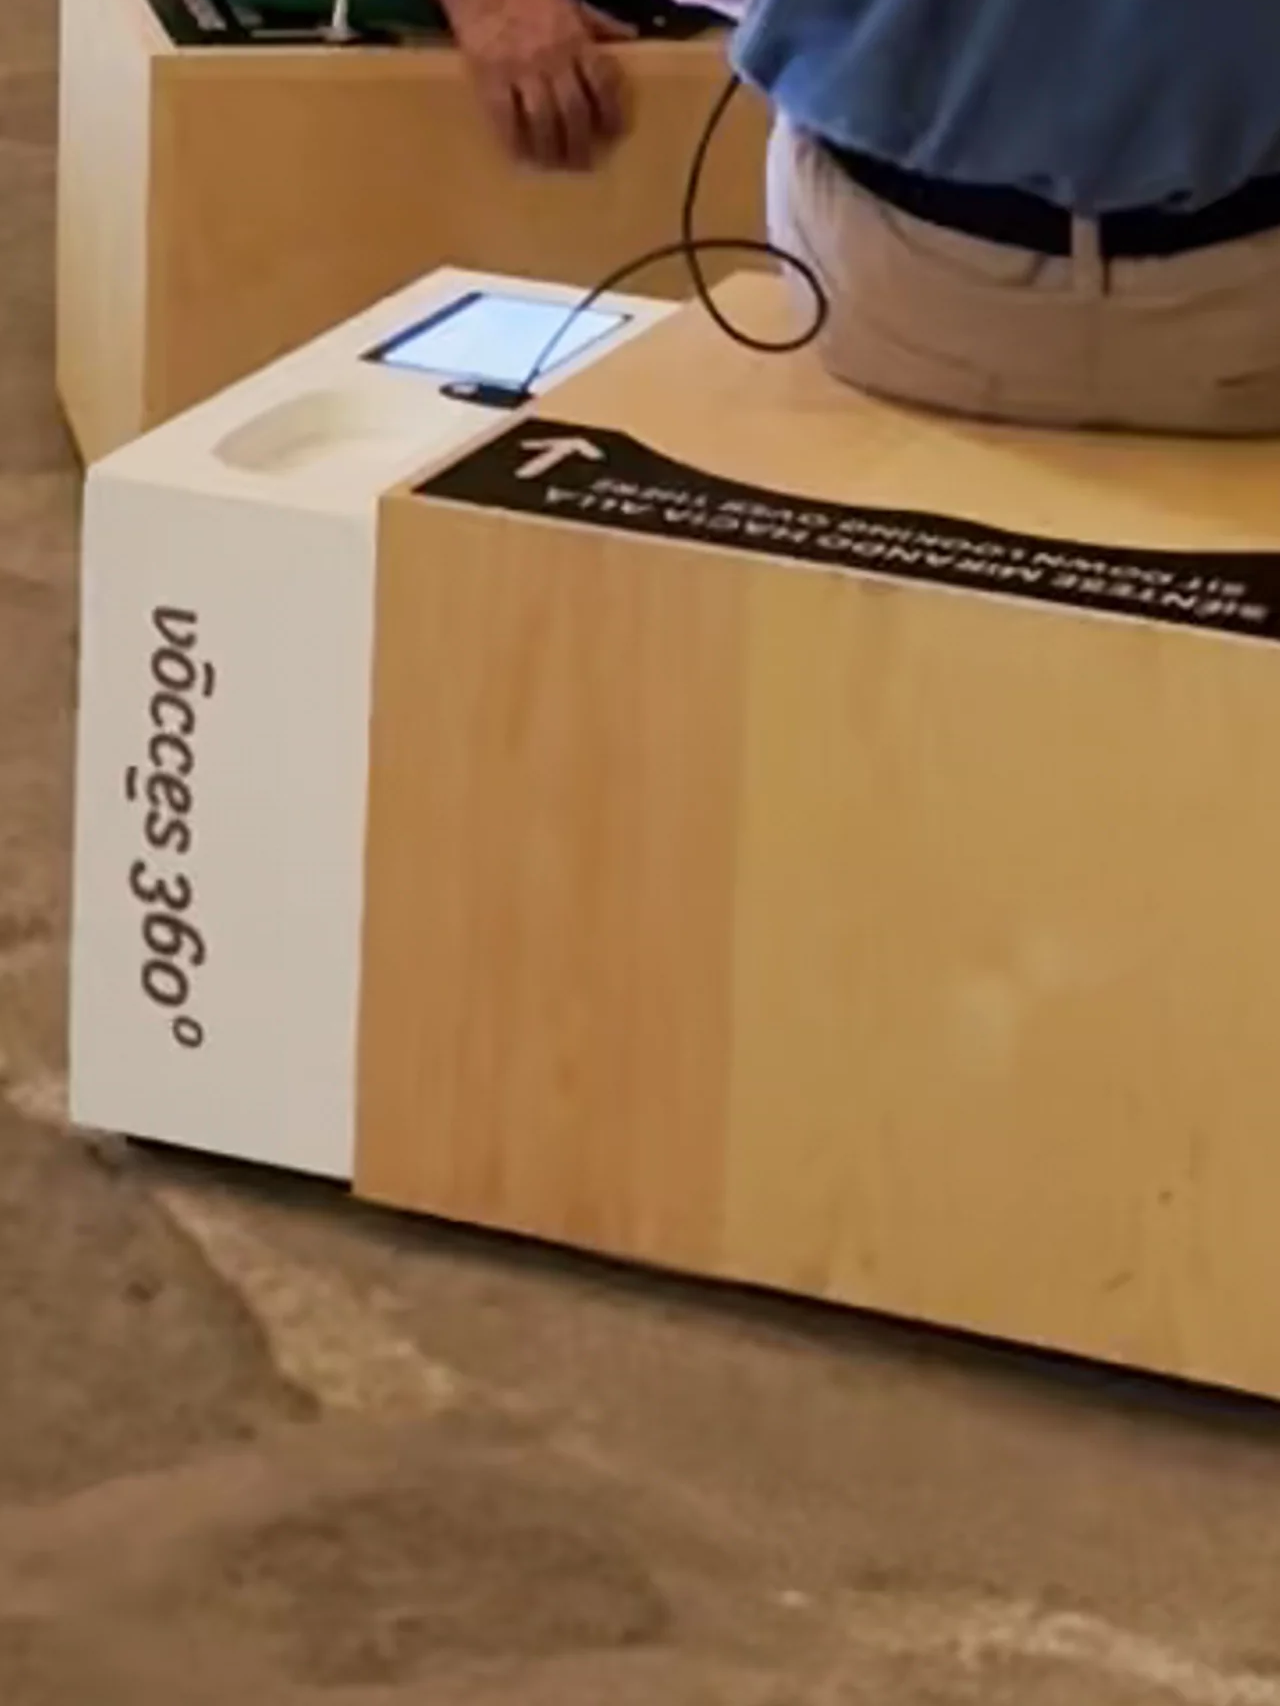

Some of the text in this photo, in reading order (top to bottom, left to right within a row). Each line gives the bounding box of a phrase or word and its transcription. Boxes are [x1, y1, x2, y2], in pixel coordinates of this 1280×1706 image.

[591, 479, 1247, 597] SIT DOWN LOOKING OVER THERE
[663, 509, 811, 543] HACIA
[817, 536, 1043, 583] MIRANDO
